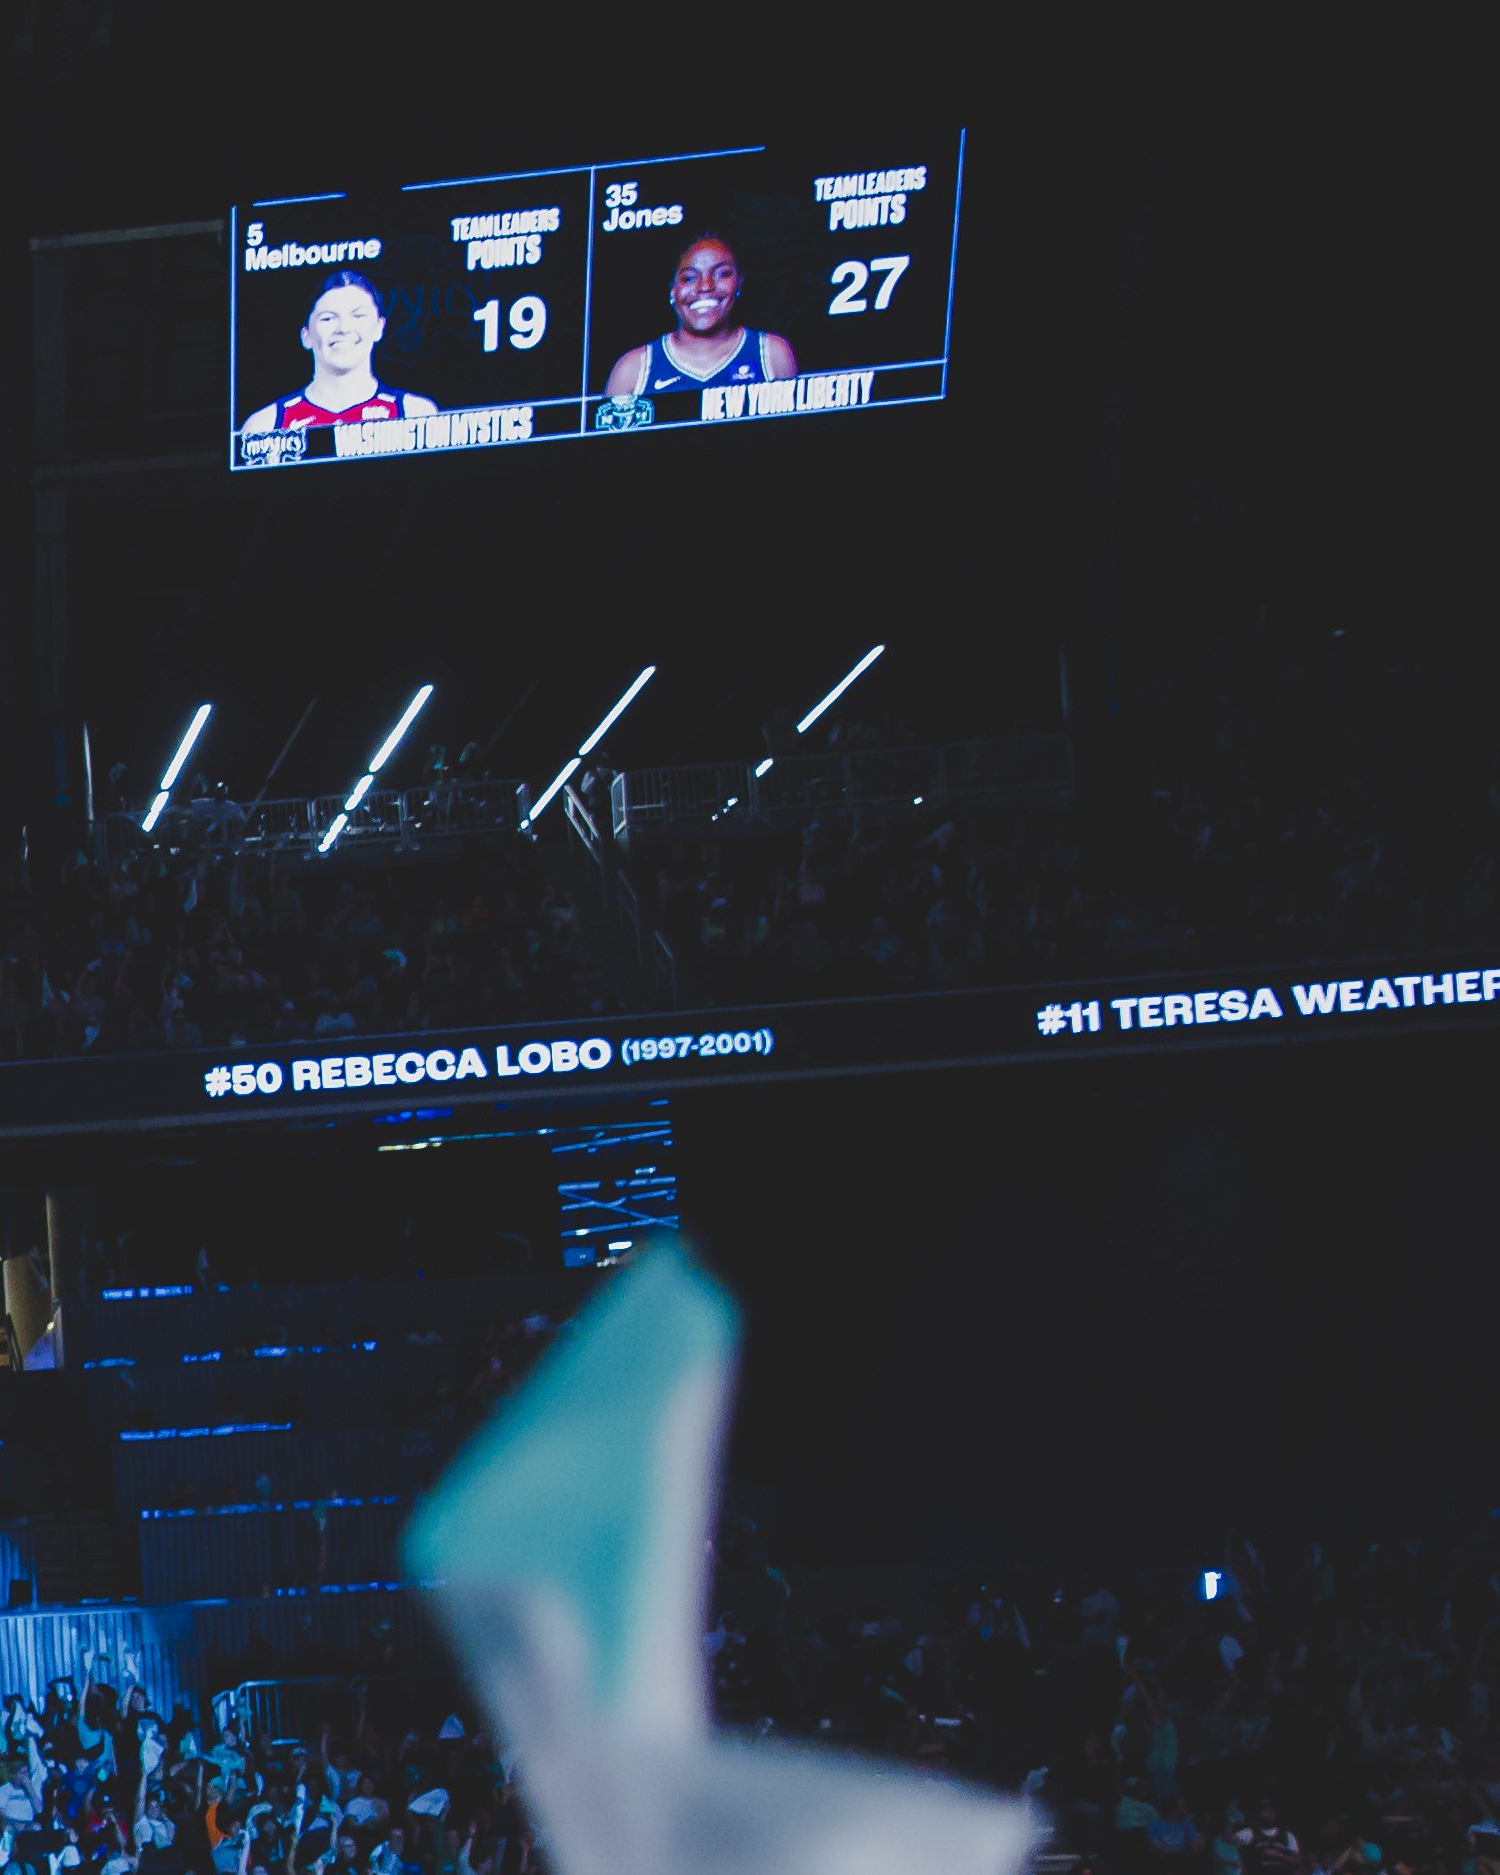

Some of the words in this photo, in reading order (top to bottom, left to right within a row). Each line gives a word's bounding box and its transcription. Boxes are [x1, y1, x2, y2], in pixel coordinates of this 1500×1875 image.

[604, 182, 638, 208] 35
[815, 174, 858, 202] TEAM
[858, 166, 928, 197] LEADERS
[451, 213, 493, 242] TEAM
[494, 207, 560, 238] LEADERS
[602, 204, 684, 231] Jones
[829, 194, 907, 230] POINTS
[246, 222, 264, 247] 5
[466, 234, 542, 271] POINTS
[244, 237, 382, 272] Melbourne
[828, 255, 911, 316] 27
[473, 295, 548, 353] 19
[701, 384, 746, 421] NEW
[747, 377, 798, 416] YORK
[798, 370, 876, 411] LIBERTY
[333, 413, 459, 458] WASHINGTON
[459, 405, 534, 447] MYSTICS
[1037, 1001, 1101, 1036] #11
[1110, 987, 1284, 1030] TERESA
[203, 1062, 283, 1098] #50
[291, 1046, 488, 1091] REBECCA
[496, 1037, 613, 1078] LOBO
[620, 1027, 775, 1066] (1997-2001)
